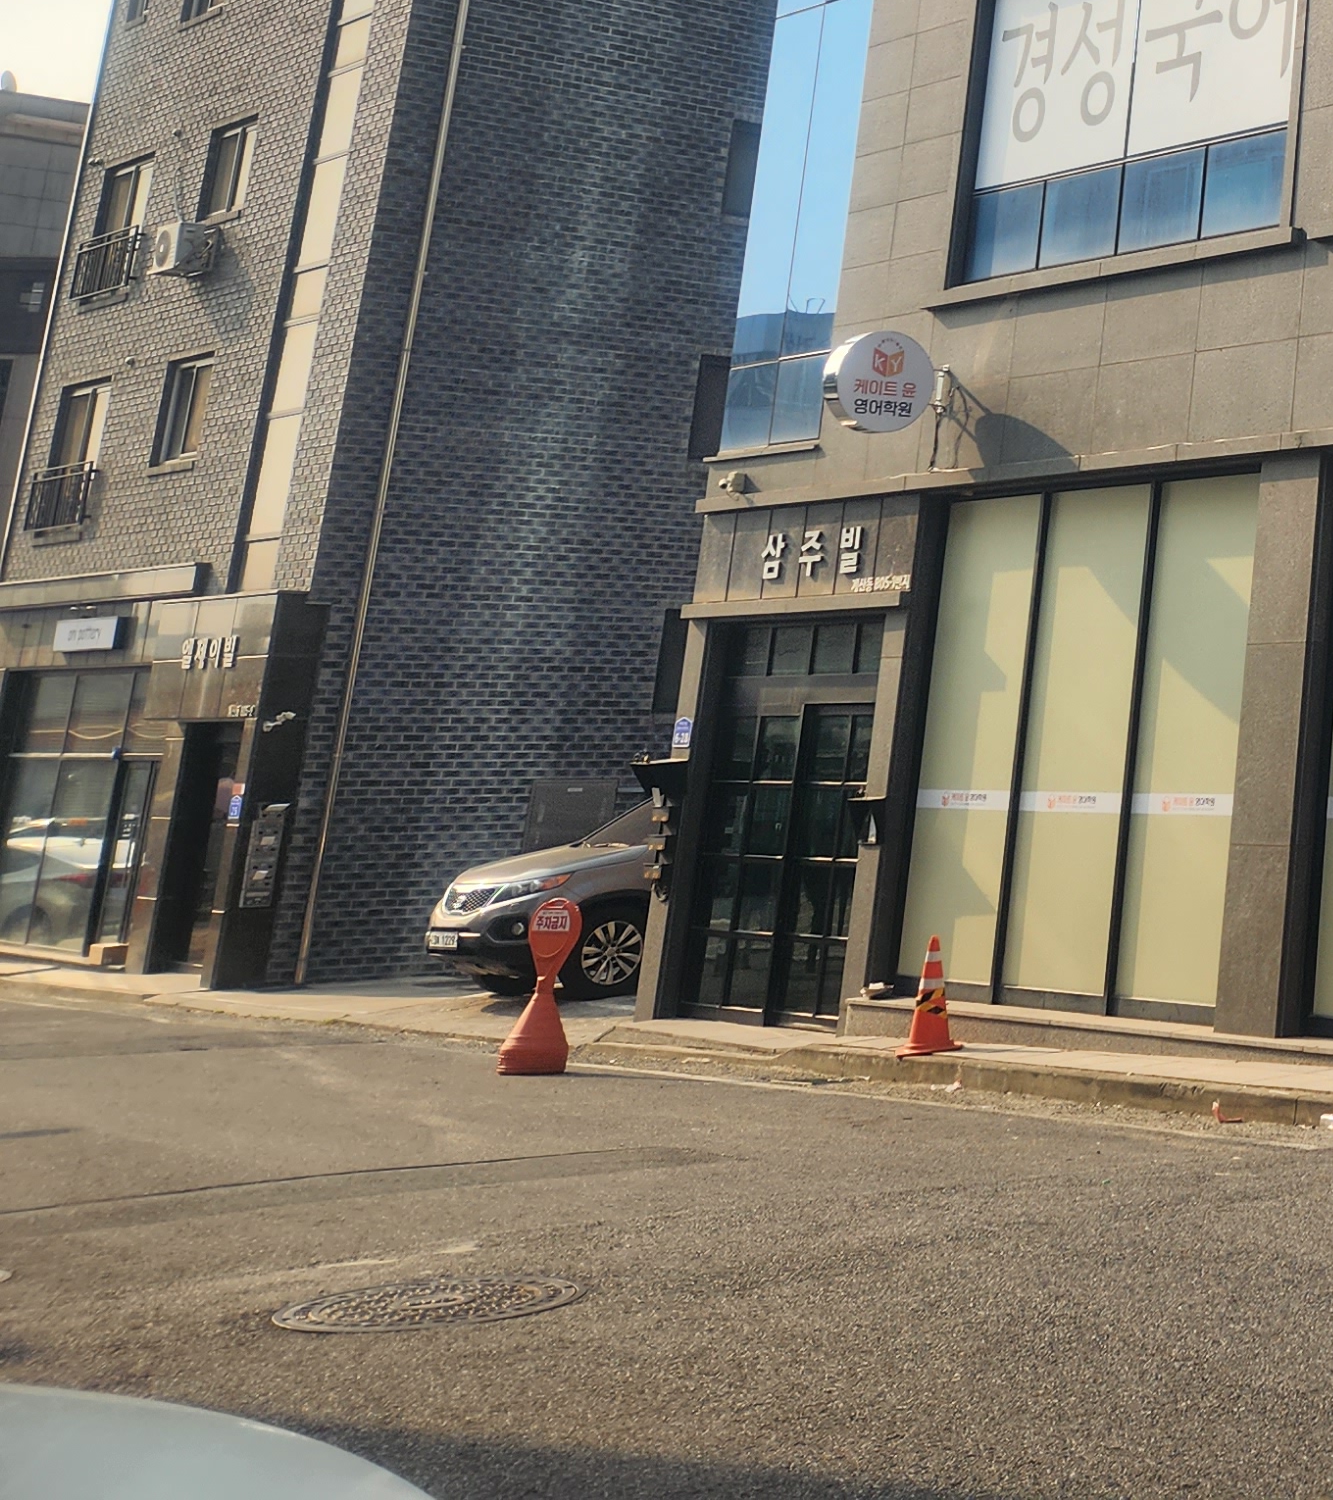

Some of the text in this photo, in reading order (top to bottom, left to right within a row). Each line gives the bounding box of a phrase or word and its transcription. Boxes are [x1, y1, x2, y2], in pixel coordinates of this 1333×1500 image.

[853, 378, 917, 398] 케이트 윤
[854, 398, 913, 418] 영어학원
[761, 526, 865, 580] 삼주빌
[536, 915, 568, 930] 주차금지
